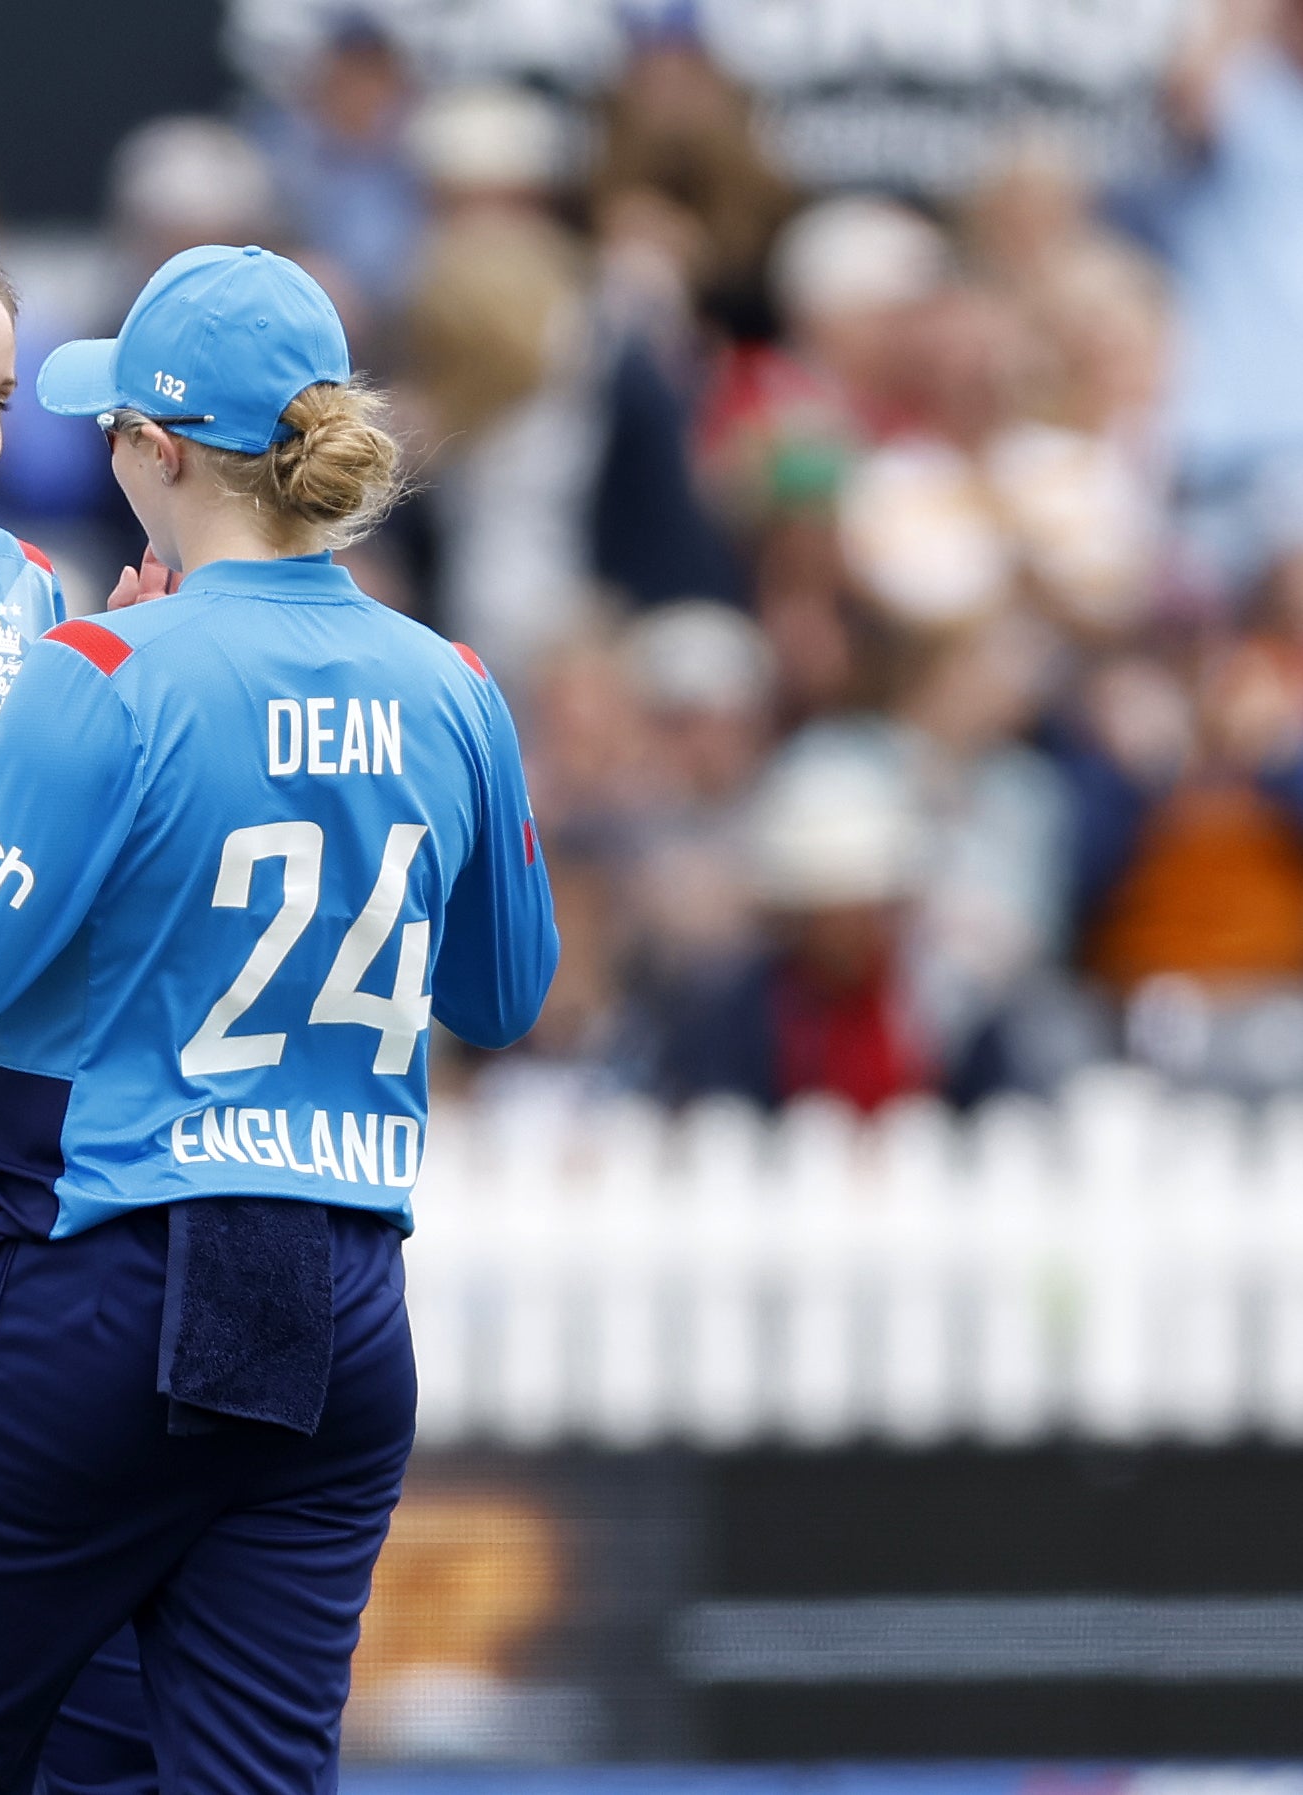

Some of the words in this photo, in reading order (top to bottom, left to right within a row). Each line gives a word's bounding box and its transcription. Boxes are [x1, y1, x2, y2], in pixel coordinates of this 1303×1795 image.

[154, 370, 187, 401] 132
[268, 697, 403, 776] DEAN
[181, 821, 433, 1077] 24
[171, 1106, 419, 1188] ENGLAND
